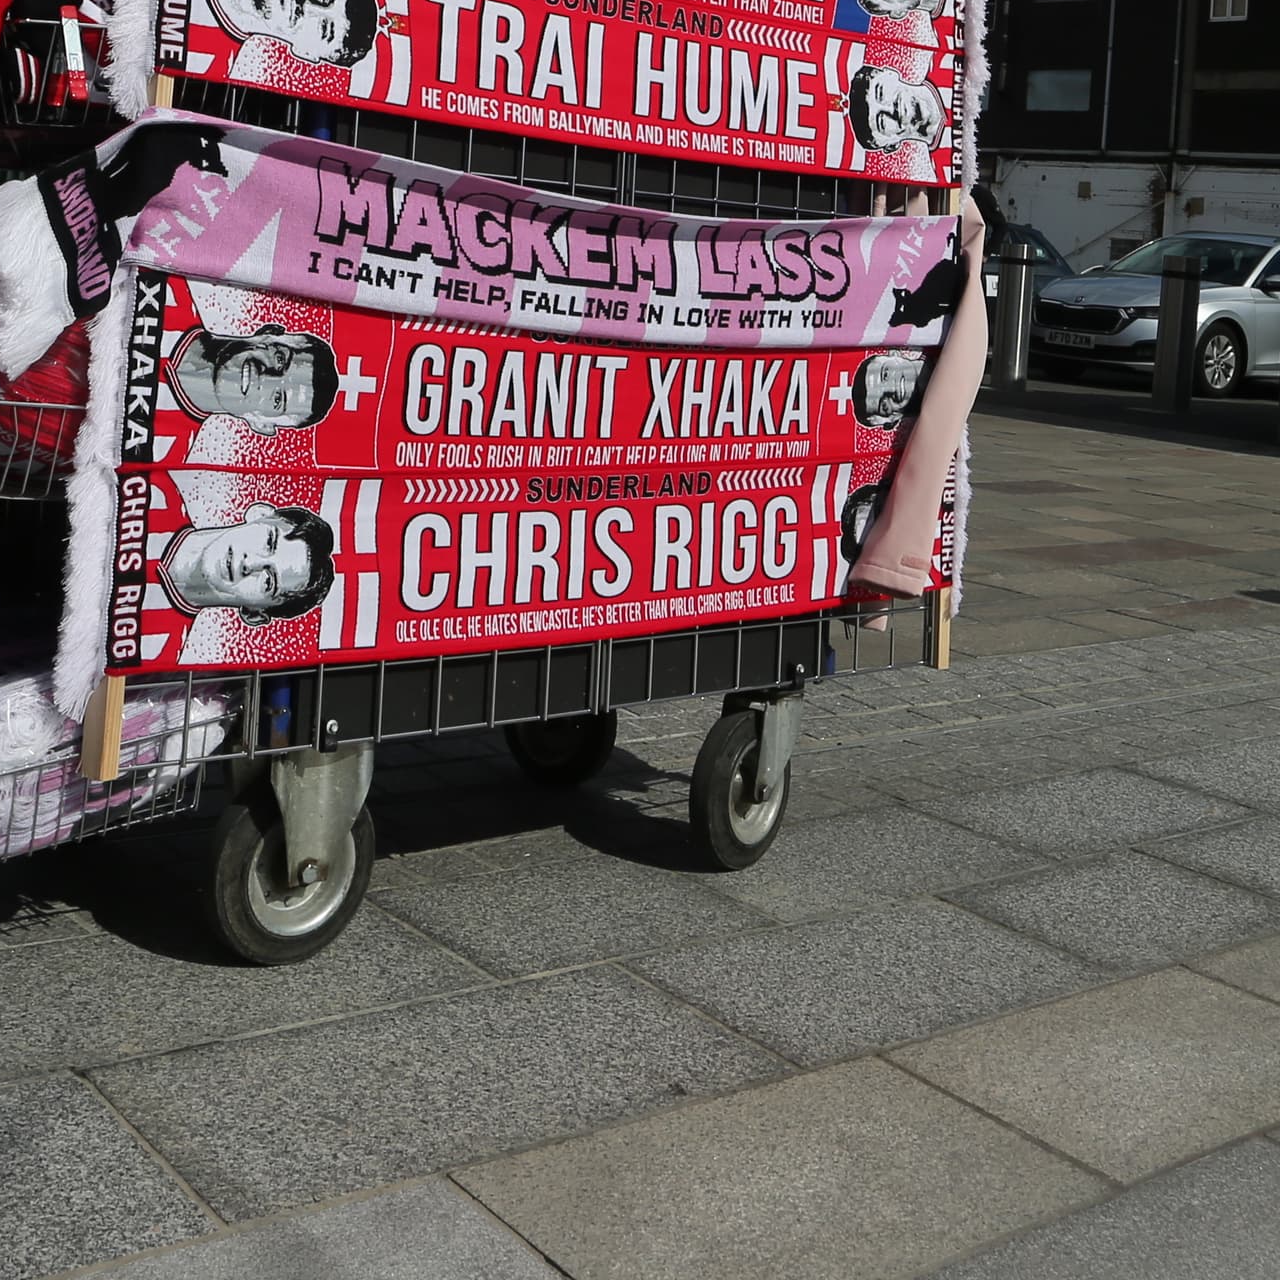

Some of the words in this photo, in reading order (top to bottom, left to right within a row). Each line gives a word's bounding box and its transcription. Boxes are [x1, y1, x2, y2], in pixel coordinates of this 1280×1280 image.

[773, 0, 824, 25] ZIDANE!
[634, 31, 818, 140] HUME
[952, 61, 966, 120] HUME
[421, 86, 442, 111] HE
[447, 90, 499, 120] COMES
[503, 101, 544, 128] FROM
[549, 109, 632, 142] BALLYMENA
[635, 124, 663, 146] AND
[667, 128, 689, 149] HIS
[692, 132, 728, 155] NAME
[732, 136, 744, 156] IS
[747, 138, 775, 160] TRAI
[778, 143, 815, 165] HUME!
[952, 127, 963, 178] TRAI
[53, 168, 111, 300] SNDERAND
[314, 156, 678, 296] MACKEM
[695, 225, 851, 303] LASS
[308, 251, 322, 273] I
[333, 257, 423, 294] CAN'T
[433, 277, 511, 312] HELP,
[520, 290, 628, 322] FALLING
[637, 303, 663, 325] IN
[673, 306, 731, 329] LOVE
[739, 309, 793, 329] WITH
[801, 308, 843, 329] YOU!
[123, 282, 161, 451] XHAKA
[403, 343, 628, 438] GRANIT
[641, 358, 809, 439] XHAKA
[395, 441, 432, 468] ONLY
[437, 443, 483, 468] FOOLS
[487, 445, 523, 468] RUSH
[755, 440, 783, 460] WITH
[525, 471, 712, 504] SUNDERLAND
[118, 476, 146, 570] CHRIS
[400, 506, 634, 612] CHRIS
[651, 495, 798, 592] RIGG
[941, 511, 955, 576] CHRIS
[111, 584, 142, 659] RIGG
[396, 620, 417, 643] OLE
[420, 618, 440, 641] OLE
[467, 615, 482, 638] HE
[484, 612, 517, 636] HATES
[606, 602, 641, 625] BETTER
[643, 598, 668, 620] THAN
[698, 593, 722, 615] CHRIS
[747, 588, 761, 608] OLE
[763, 586, 778, 606] OLE
[780, 584, 795, 603] OLE
